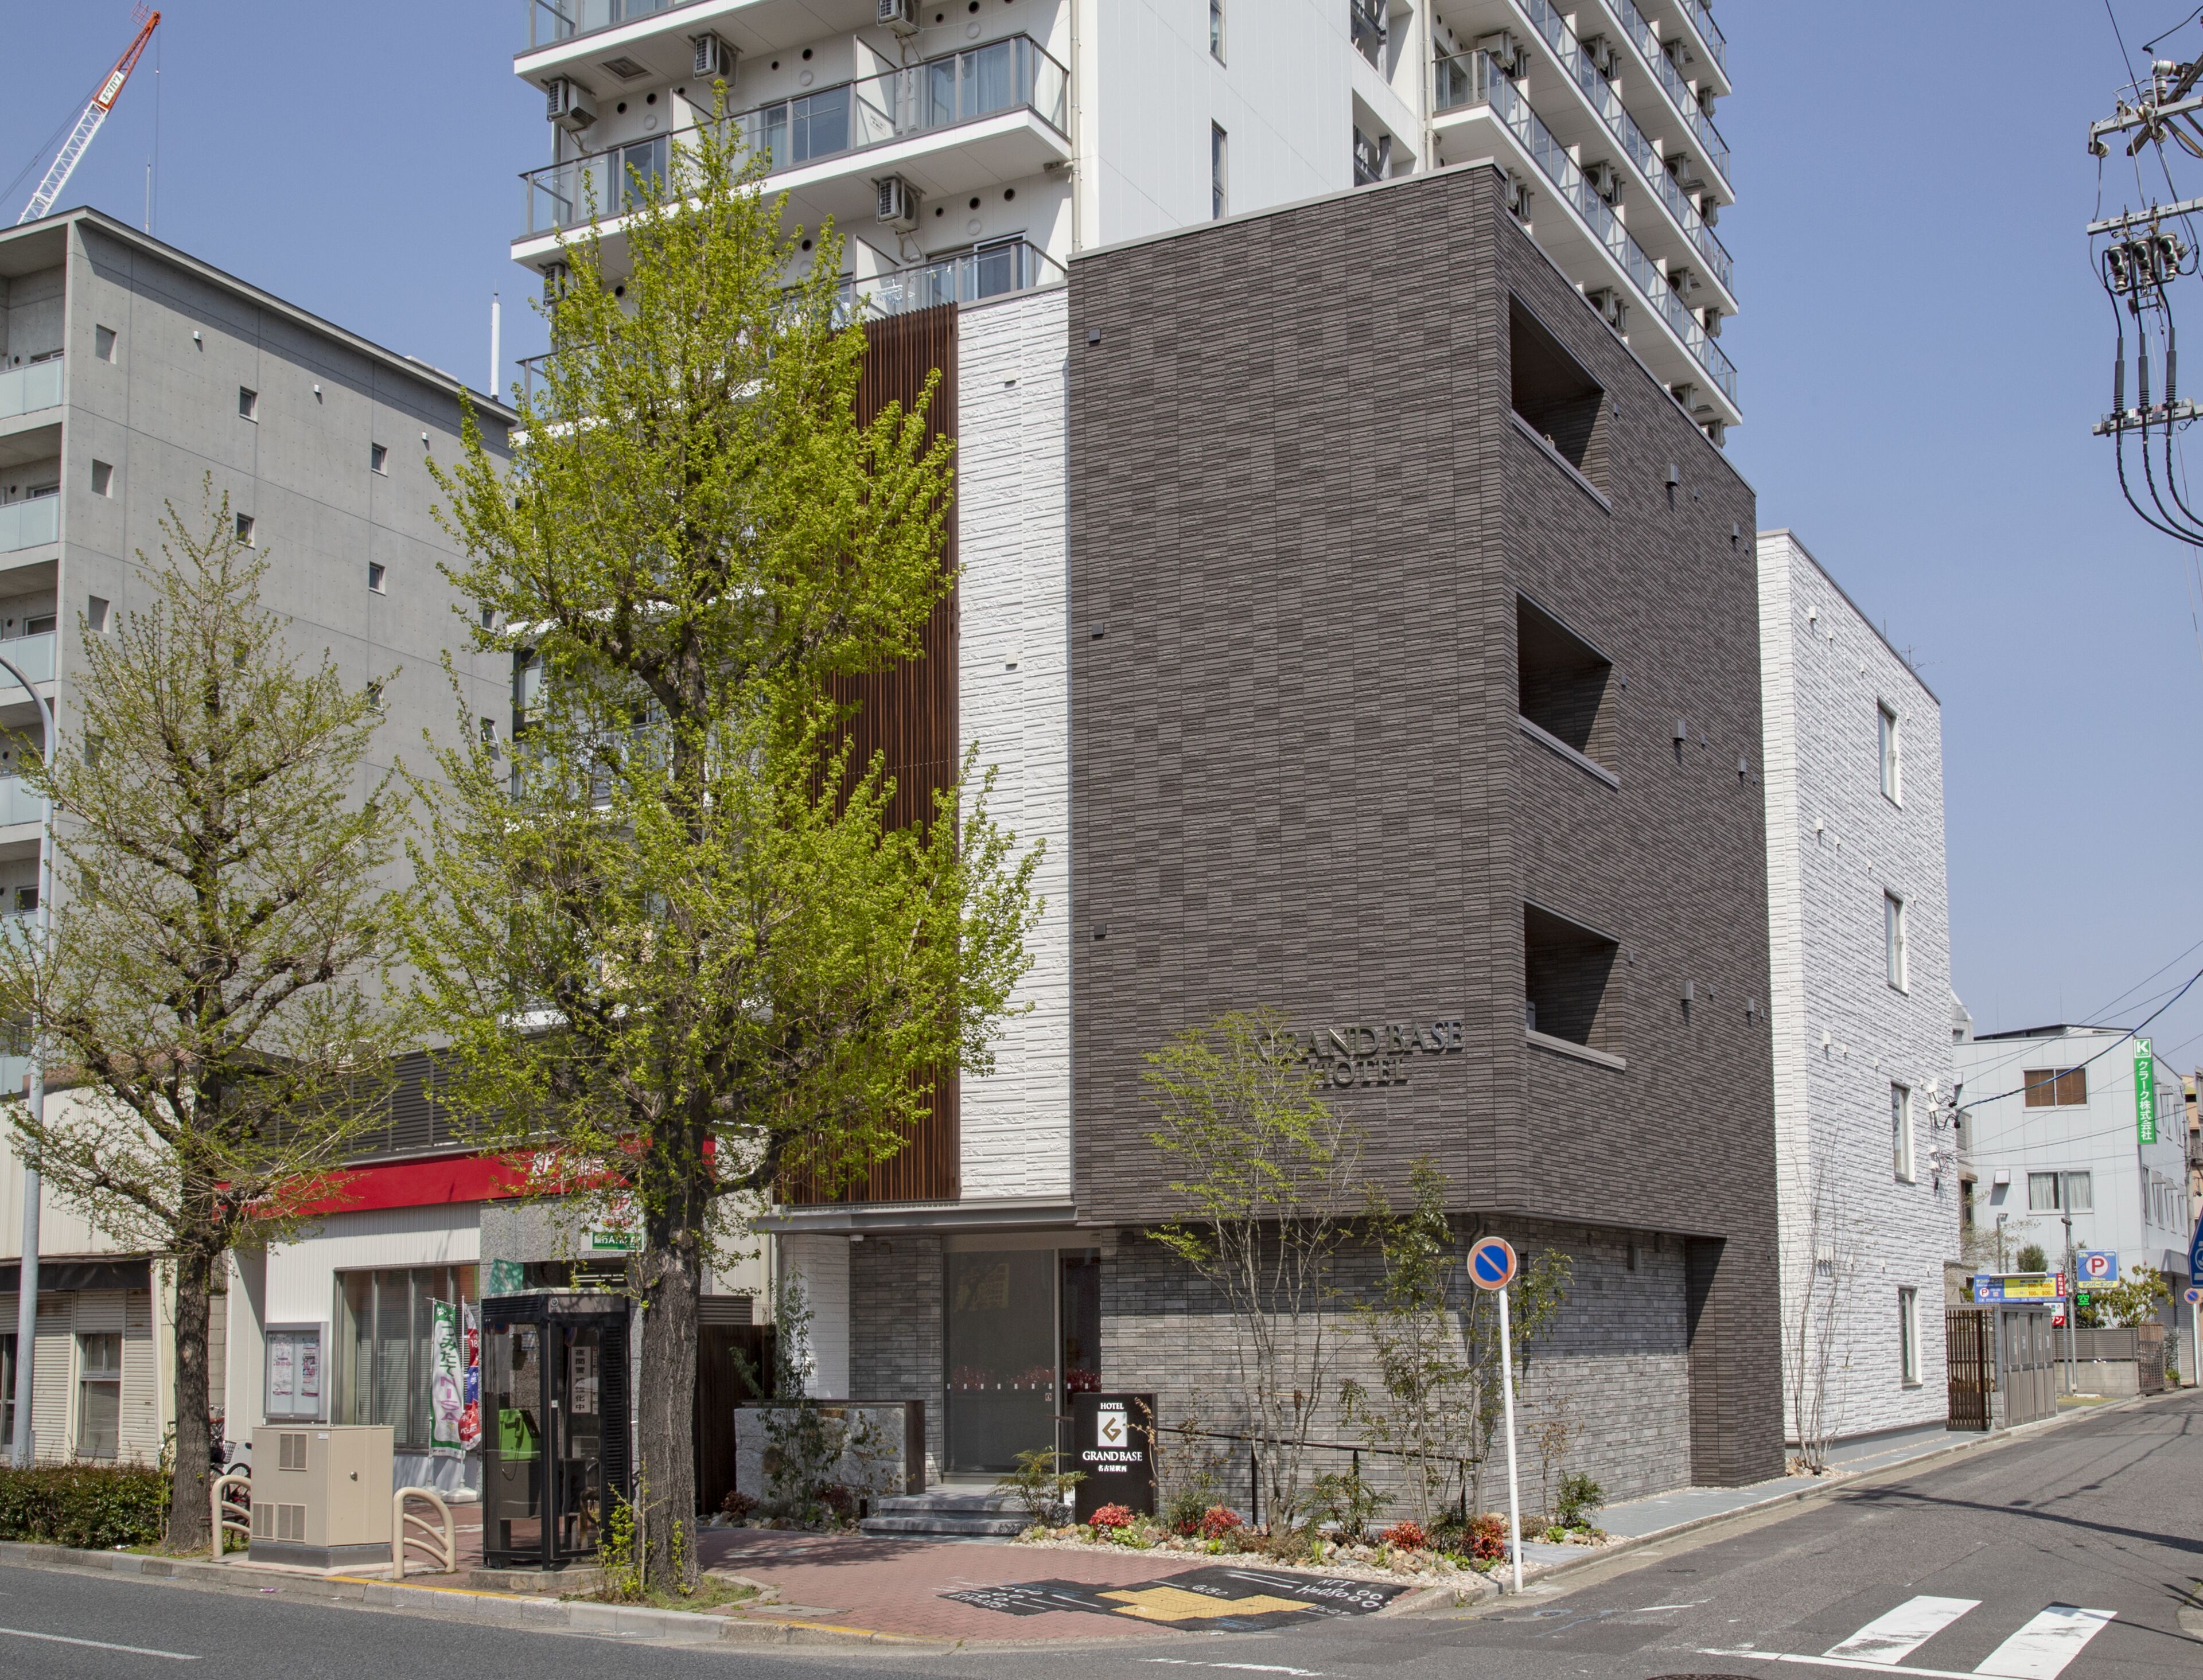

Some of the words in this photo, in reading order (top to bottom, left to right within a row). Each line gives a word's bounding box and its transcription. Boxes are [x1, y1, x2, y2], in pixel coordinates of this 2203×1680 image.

[1386, 1019, 1464, 1053] BASE
[2136, 1040, 2148, 1053] K
[1309, 1058, 1408, 1085] HOTEL
[2138, 1061, 2153, 1140] クラーク株式会社
[2091, 1258, 2104, 1273] P
[2077, 1293, 2089, 1305] 空
[1083, 1451, 1119, 1461] GRAND
[1119, 1452, 1143, 1461] BASE
[1097, 1464, 1127, 1472] 名古屋駅西
[1317, 1579, 1356, 1587] NTT
